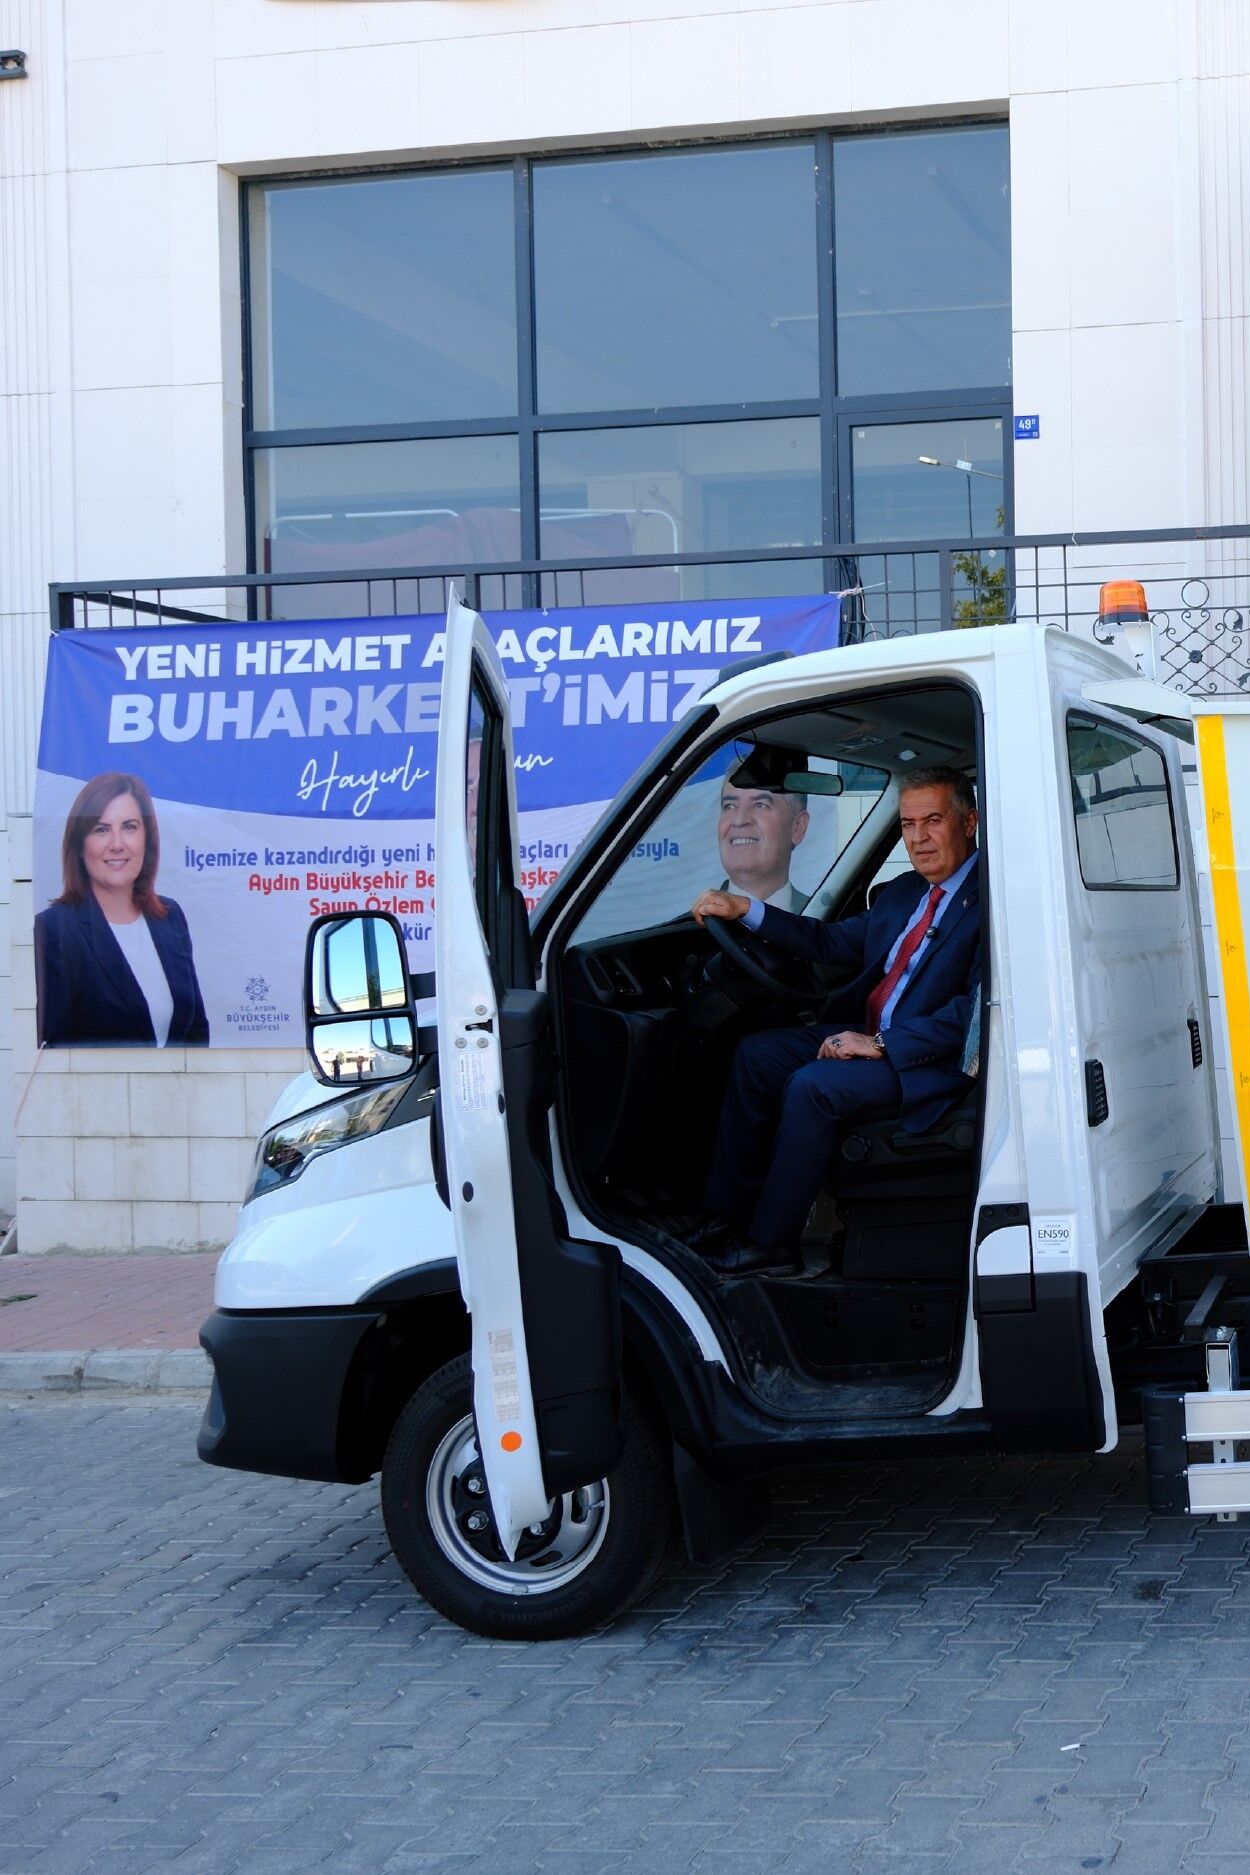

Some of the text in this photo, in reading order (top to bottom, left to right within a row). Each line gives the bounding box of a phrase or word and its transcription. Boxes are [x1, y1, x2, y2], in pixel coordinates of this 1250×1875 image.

[421, 616, 763, 675] AAÇLARIMIZ
[296, 745, 430, 820] Hayırlı
[184, 845, 259, 872] İlçemize
[264, 844, 376, 868] kazandırdığı
[382, 843, 421, 867] yeni
[248, 872, 301, 896] Aydın
[306, 869, 409, 893] Büyükşehir
[364, 892, 425, 915] Özlem
[226, 1011, 290, 1023] BÜYÜKŞEHİR
[238, 1024, 281, 1032] BELEDİYESİ
[1037, 1229, 1070, 1239] EN590
